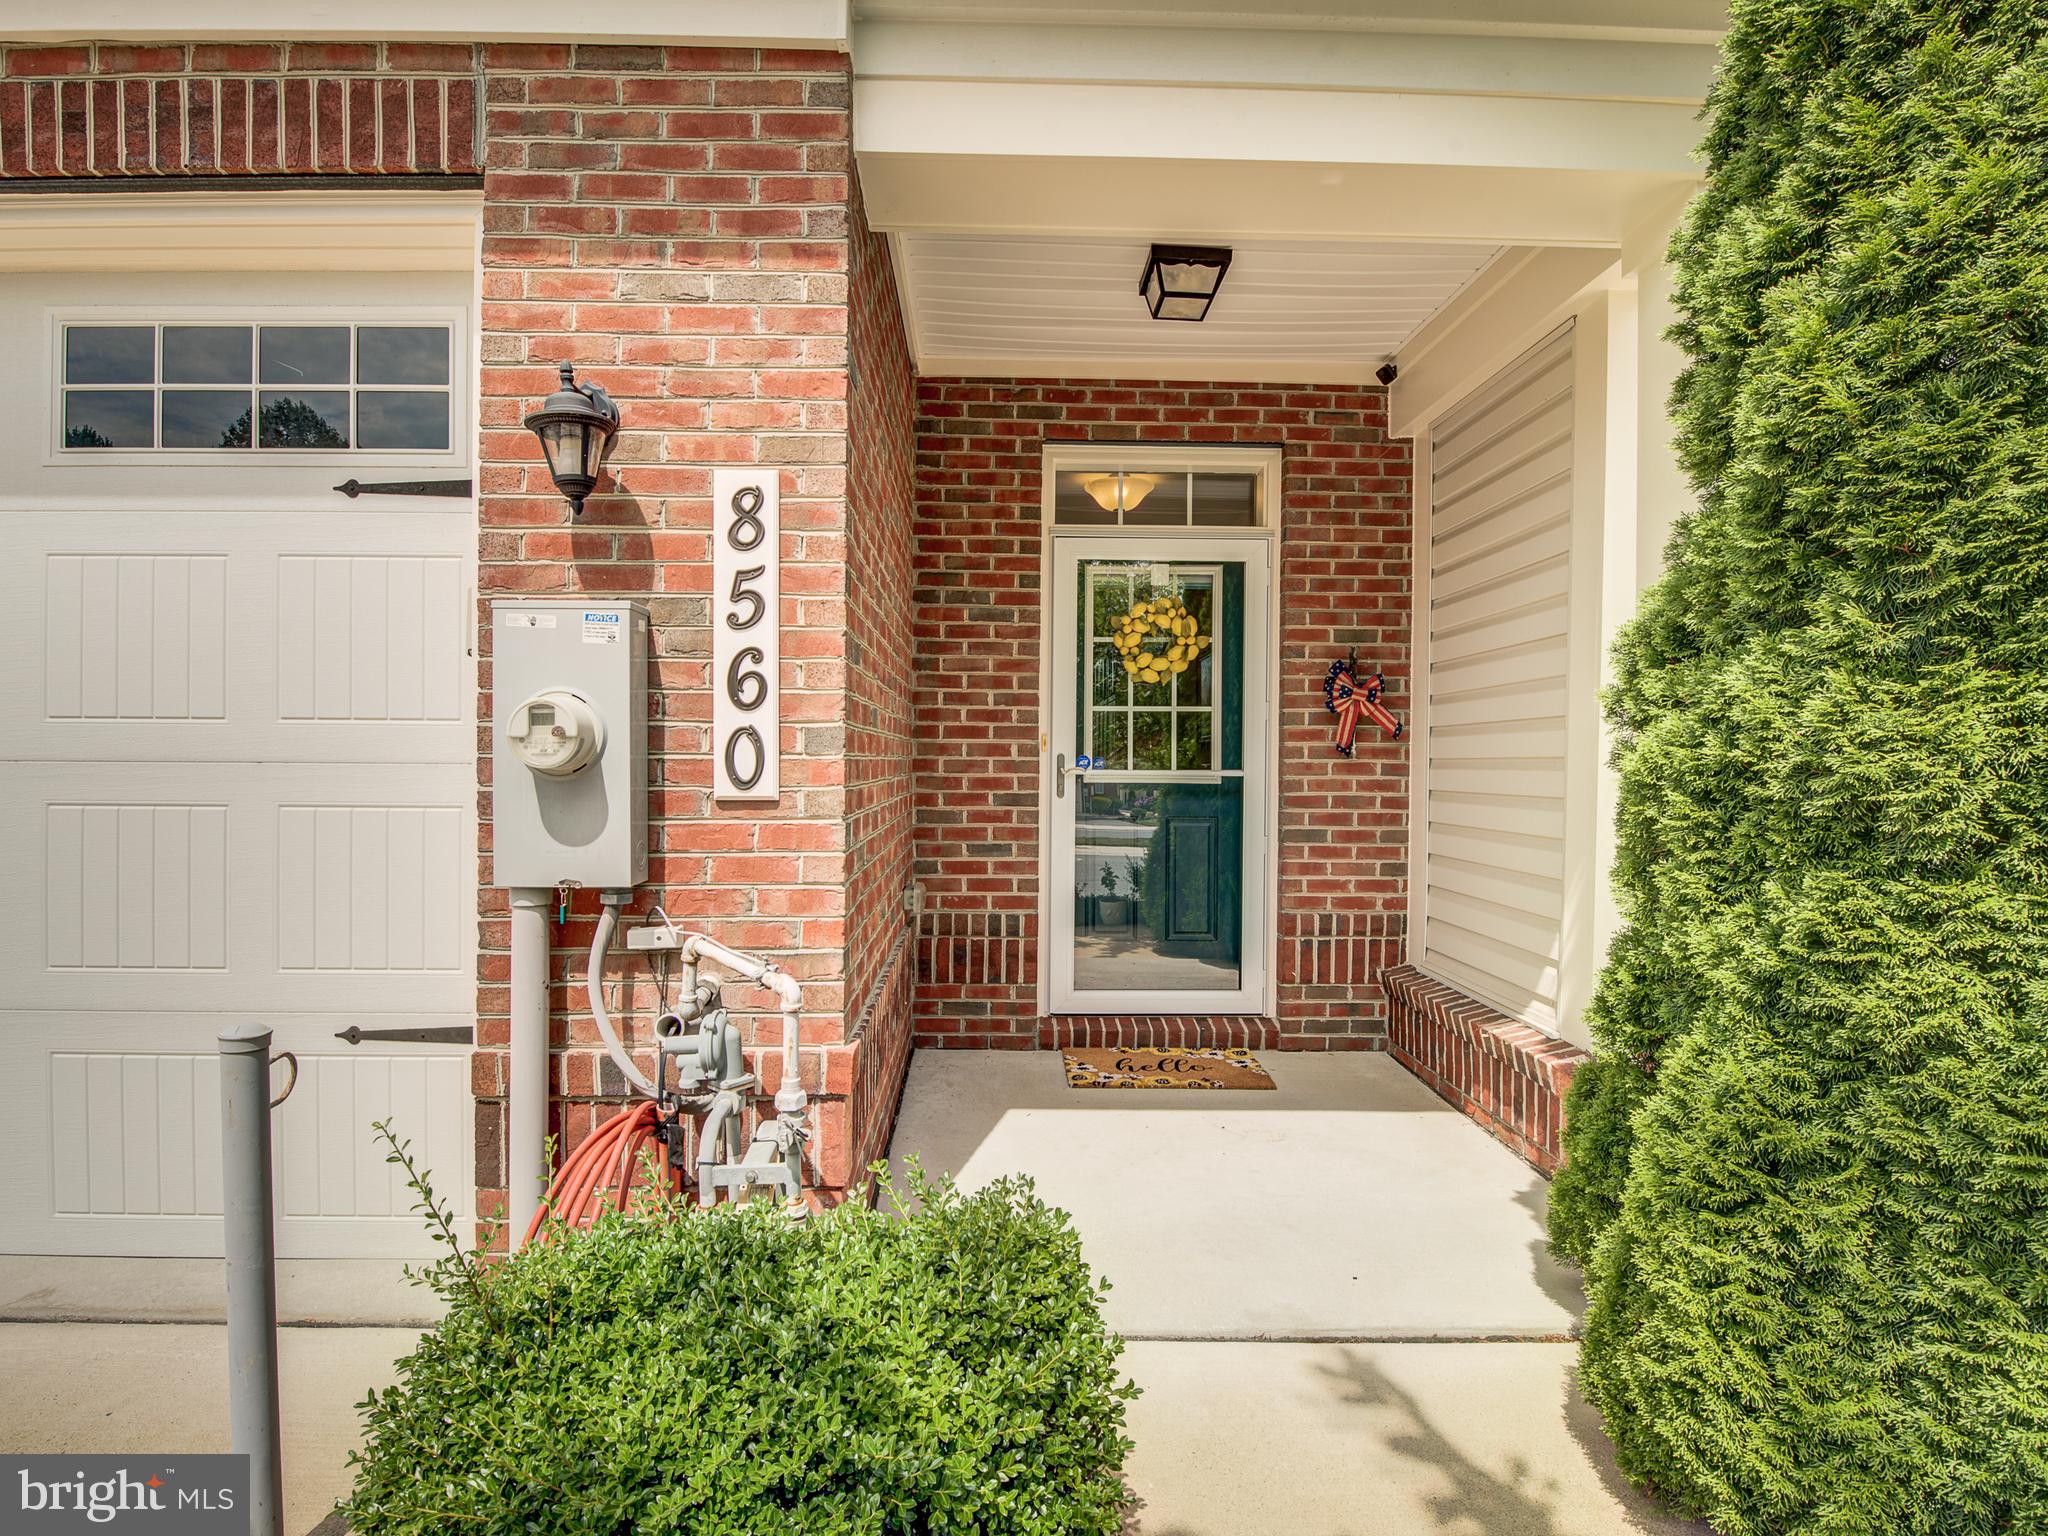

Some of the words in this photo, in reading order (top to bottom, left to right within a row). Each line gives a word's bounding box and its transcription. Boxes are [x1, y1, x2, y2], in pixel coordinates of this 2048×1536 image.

[587, 613, 617, 622] NOTICE
[724, 484, 768, 791] 8560
[1115, 1057, 1213, 1073] hello
